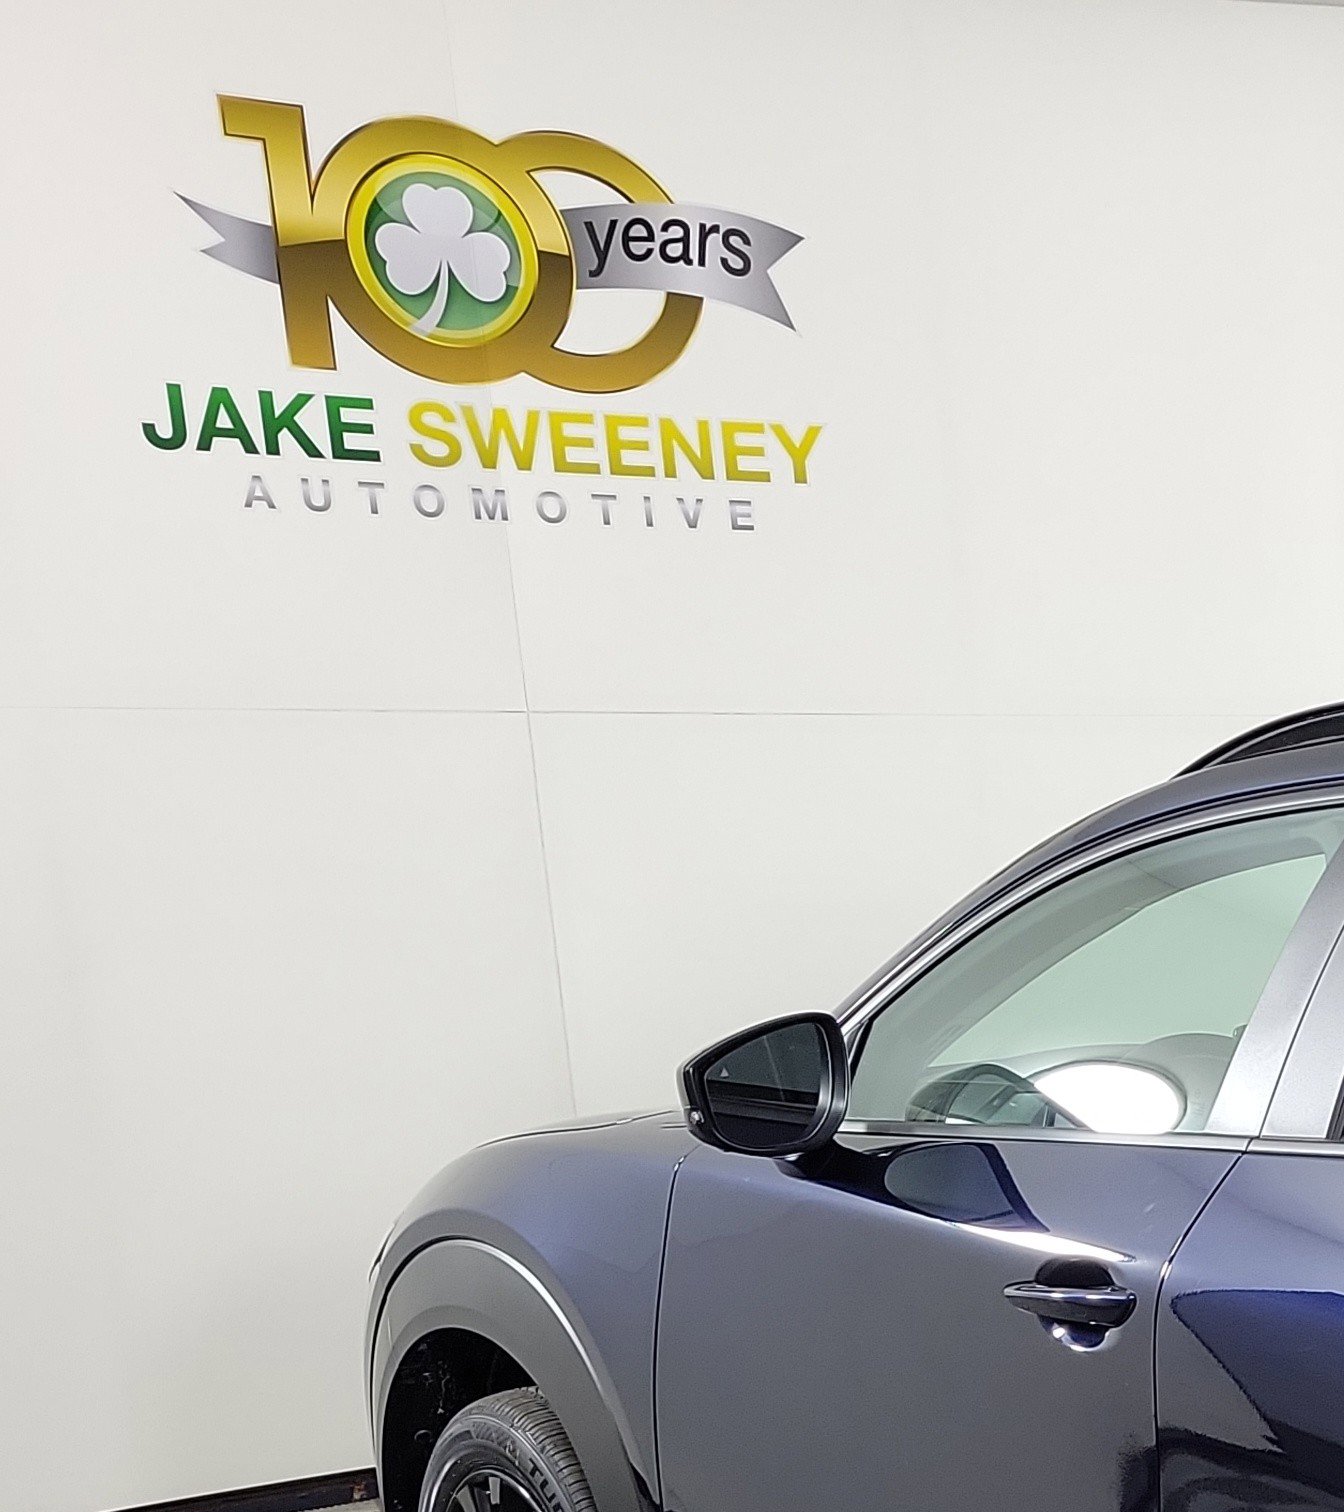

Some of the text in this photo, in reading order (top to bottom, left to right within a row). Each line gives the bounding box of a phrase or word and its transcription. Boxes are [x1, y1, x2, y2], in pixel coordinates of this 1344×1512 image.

[216, 92, 754, 394] 100 years
[141, 382, 824, 485] JAKE SWEENEY
[243, 475, 755, 532] AUTOMOTIVE
